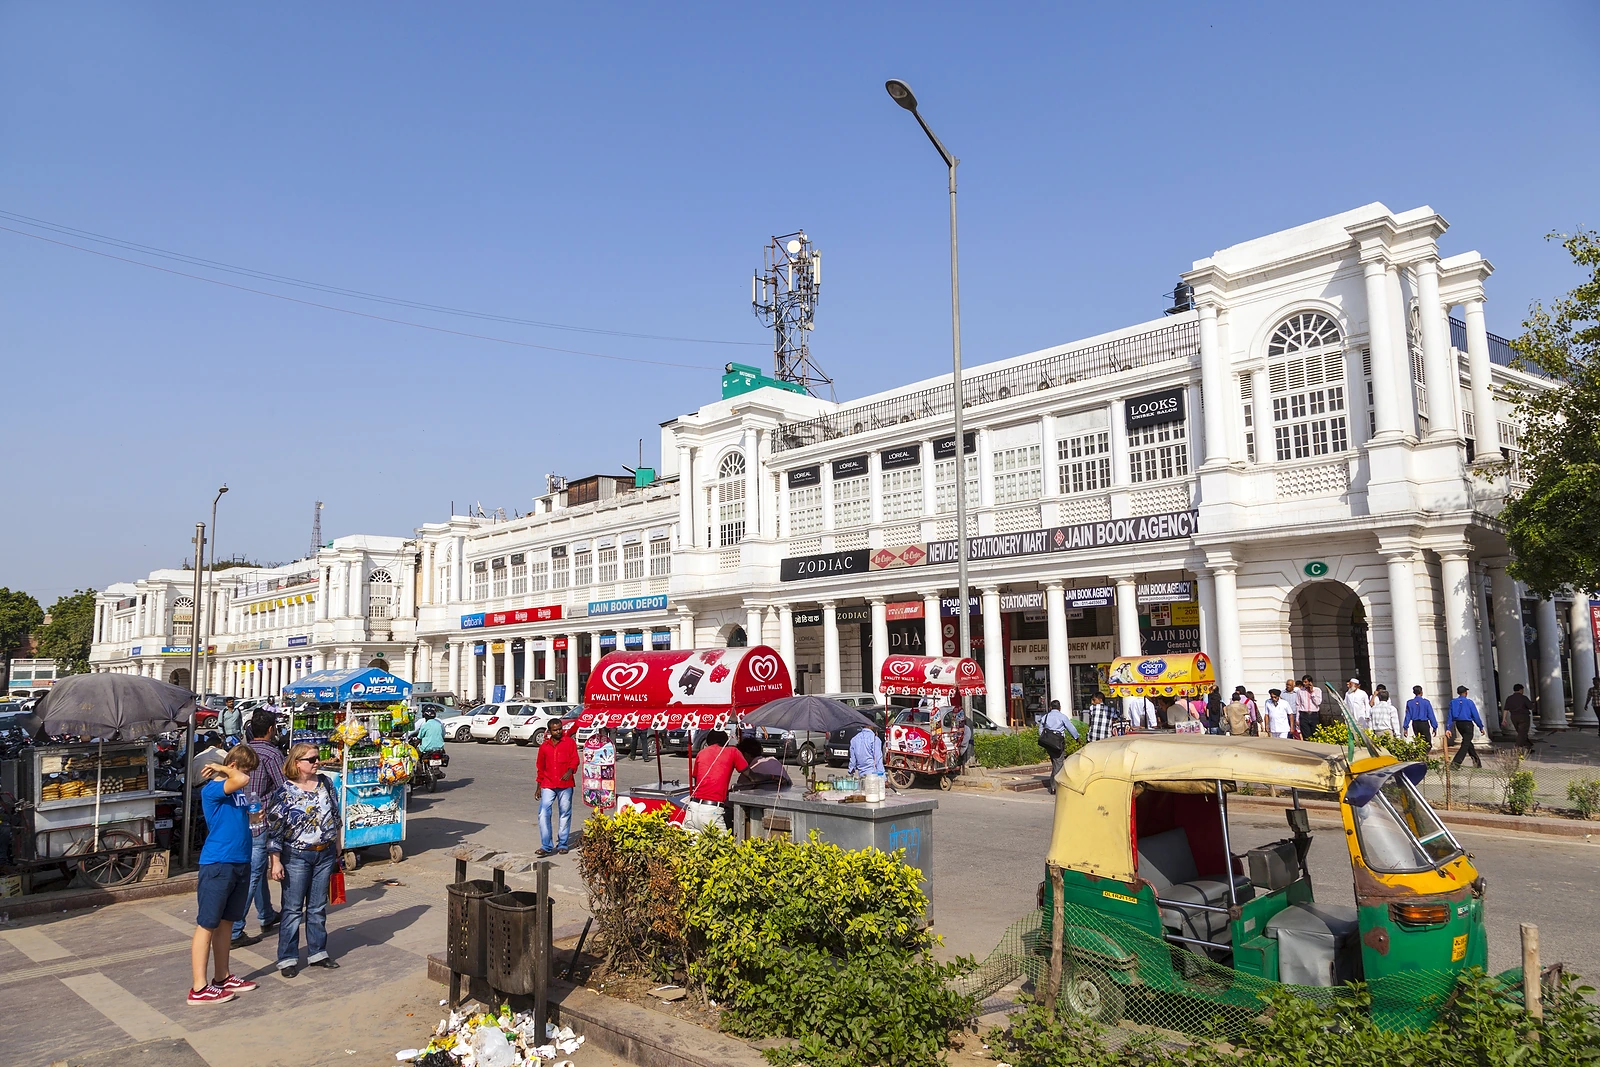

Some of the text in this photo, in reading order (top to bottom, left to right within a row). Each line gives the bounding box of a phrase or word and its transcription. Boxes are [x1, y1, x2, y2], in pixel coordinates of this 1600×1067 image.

[1131, 398, 1177, 415] LOOKS
[1157, 407, 1177, 415] SALON
[1065, 511, 1198, 549] JAIN BOOK AGENCY
[929, 531, 1048, 563] NEW DEI STATIONERY MART
[798, 557, 853, 574] ZODIAC
[1311, 563, 1321, 575] C
[1066, 586, 1113, 600] JAIN BOOK AGENCY
[1137, 582, 1191, 595] JAIN BOOK AGENCY
[590, 603, 608, 614] JAIN
[610, 600, 634, 612] BOOK
[636, 597, 664, 609] DEPOT
[1001, 593, 1043, 609] STATIONERY
[837, 611, 868, 620] ZODIAC
[1151, 629, 1198, 641] JAIN BOO
[1013, 644, 1027, 653] NEW
[1029, 644, 1048, 653] DELHI
[1091, 641, 1110, 650] MART
[1145, 667, 1158, 675] bell
[366, 685, 398, 694] PEPSI
[746, 683, 783, 693] KWALITY WALL'S
[591, 694, 648, 702] KWALITY WALL'S
[364, 814, 394, 824] PEPSI
